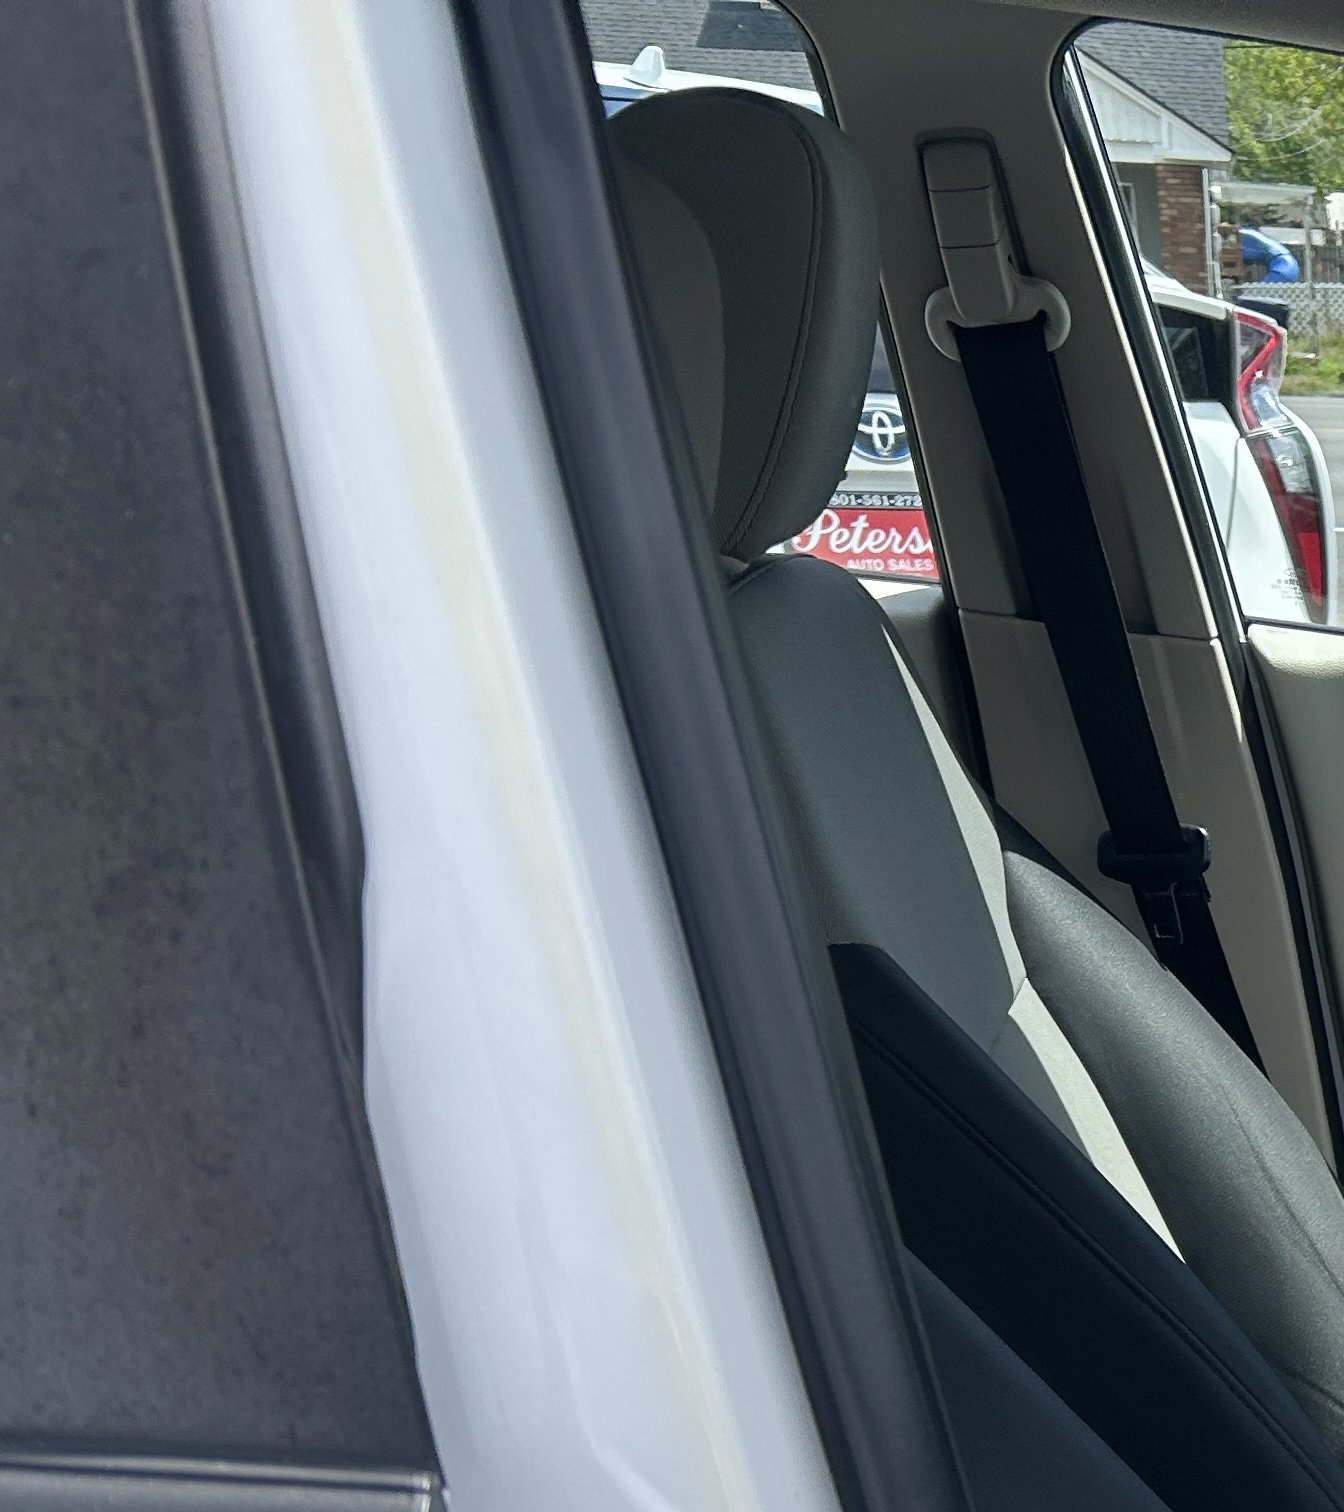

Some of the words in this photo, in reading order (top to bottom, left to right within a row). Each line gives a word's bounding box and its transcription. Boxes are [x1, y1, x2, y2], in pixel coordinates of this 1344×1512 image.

[791, 508, 934, 555] Peters
[847, 558, 884, 571] AUTO
[887, 558, 932, 571] SALES
